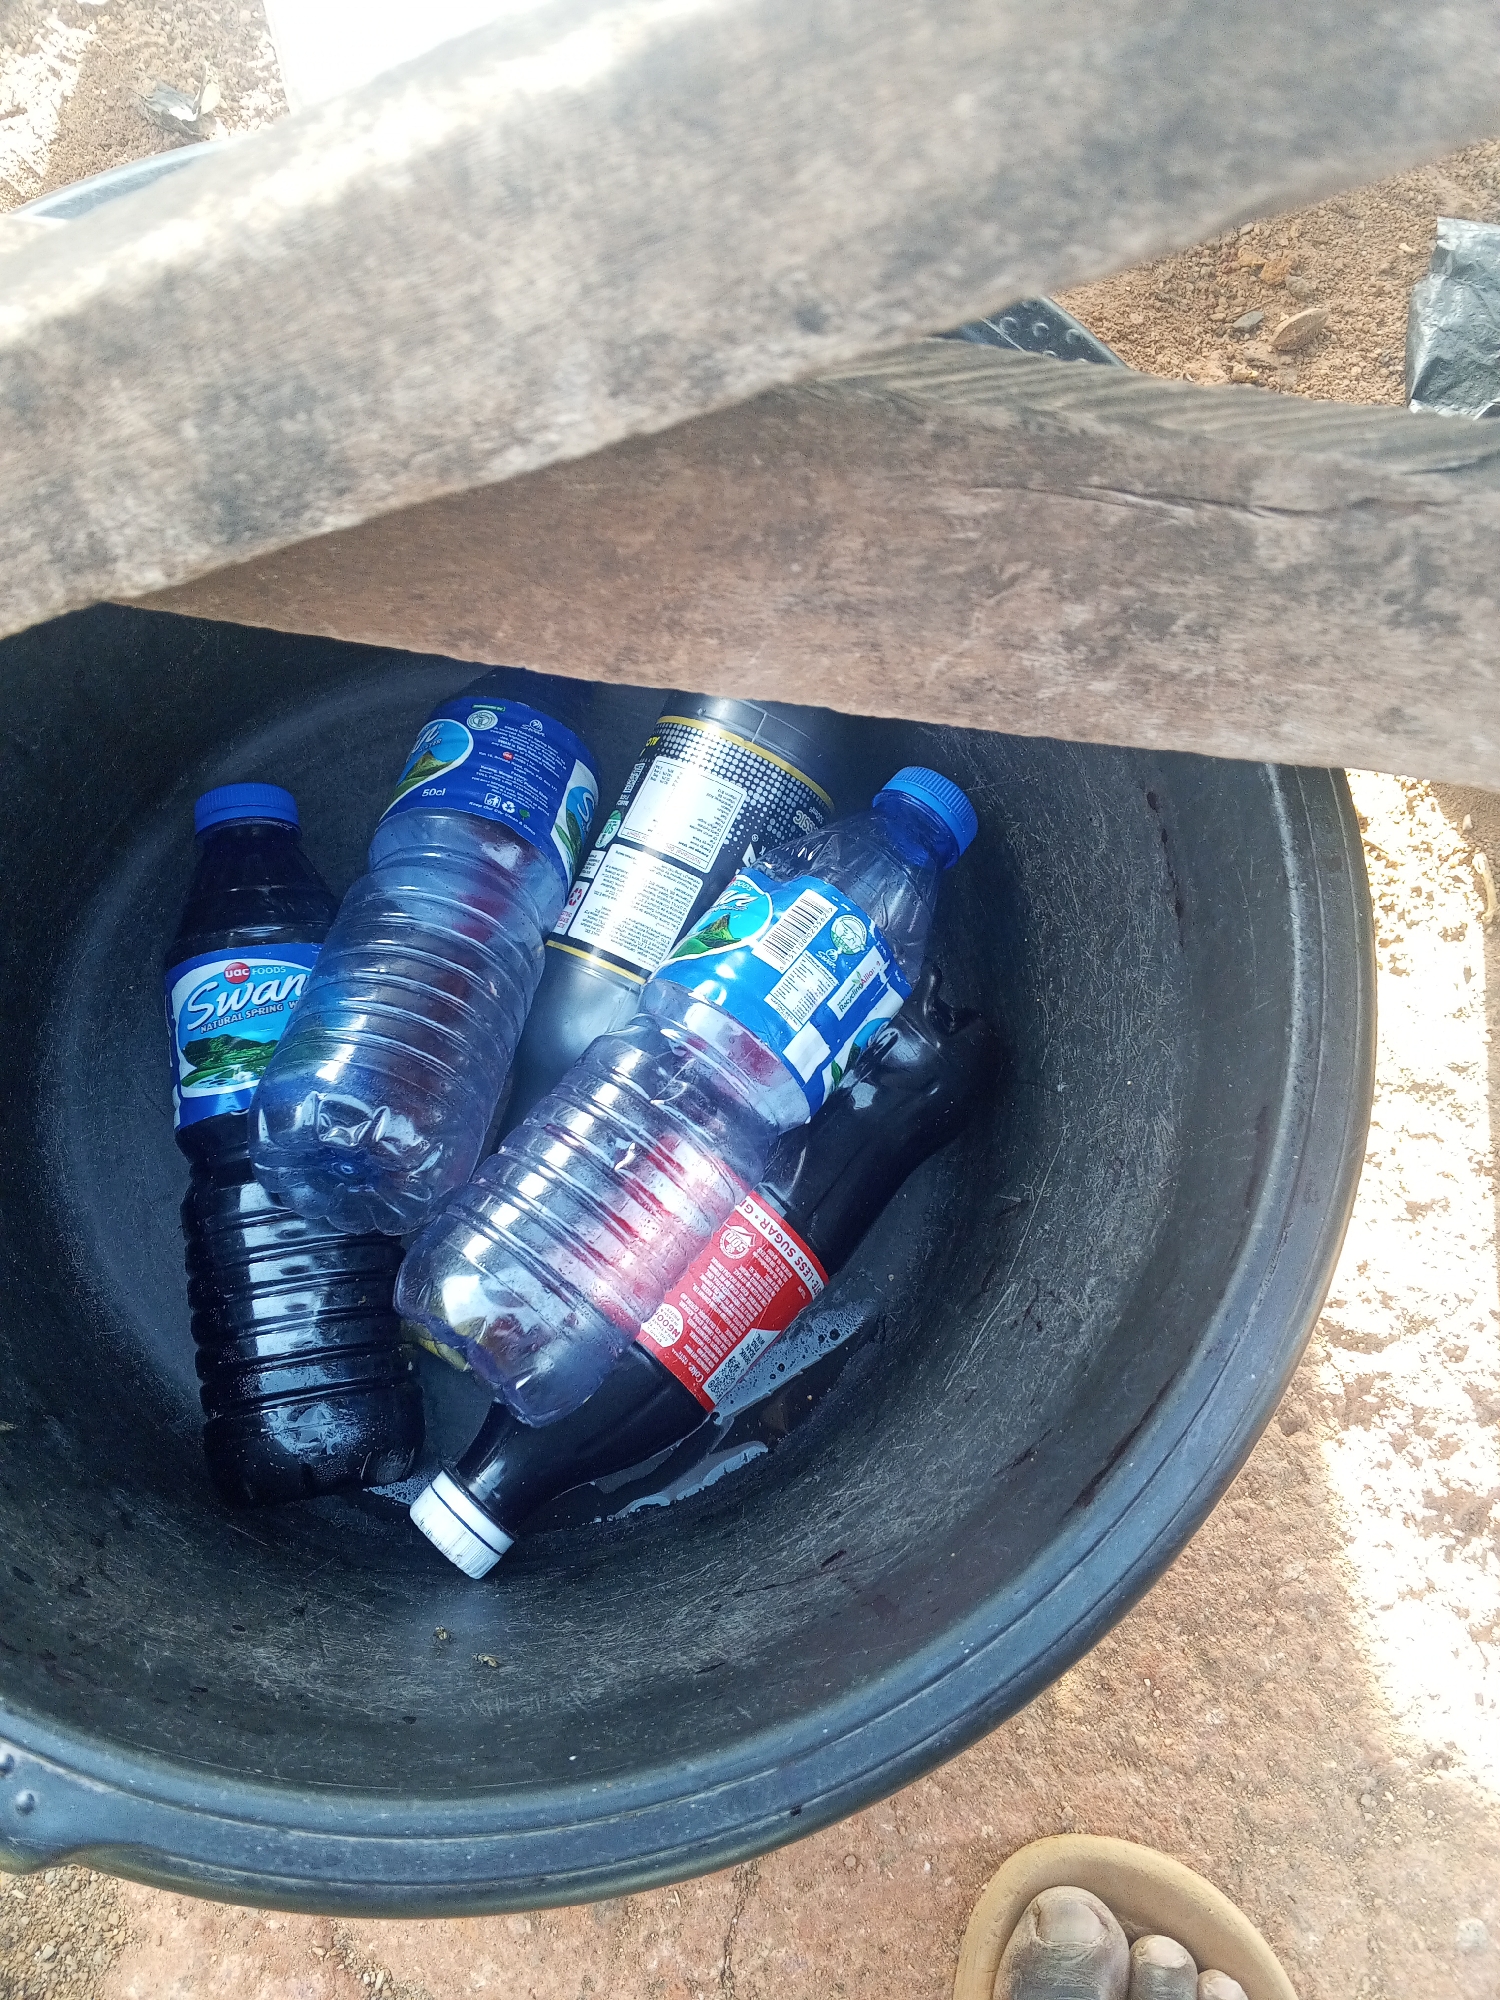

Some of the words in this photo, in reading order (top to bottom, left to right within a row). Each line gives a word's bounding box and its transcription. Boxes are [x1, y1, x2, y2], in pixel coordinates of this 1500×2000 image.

[422, 787, 446, 797] 50cl
[252, 966, 286, 976] FOODS
[187, 973, 309, 1031] Swan
[200, 1011, 243, 1034] NATURAL
[246, 1002, 283, 1019] SPRING
[758, 1217, 797, 1257] SUGAR
[793, 1255, 815, 1279] LESS
[686, 1363, 705, 1383] Coke
